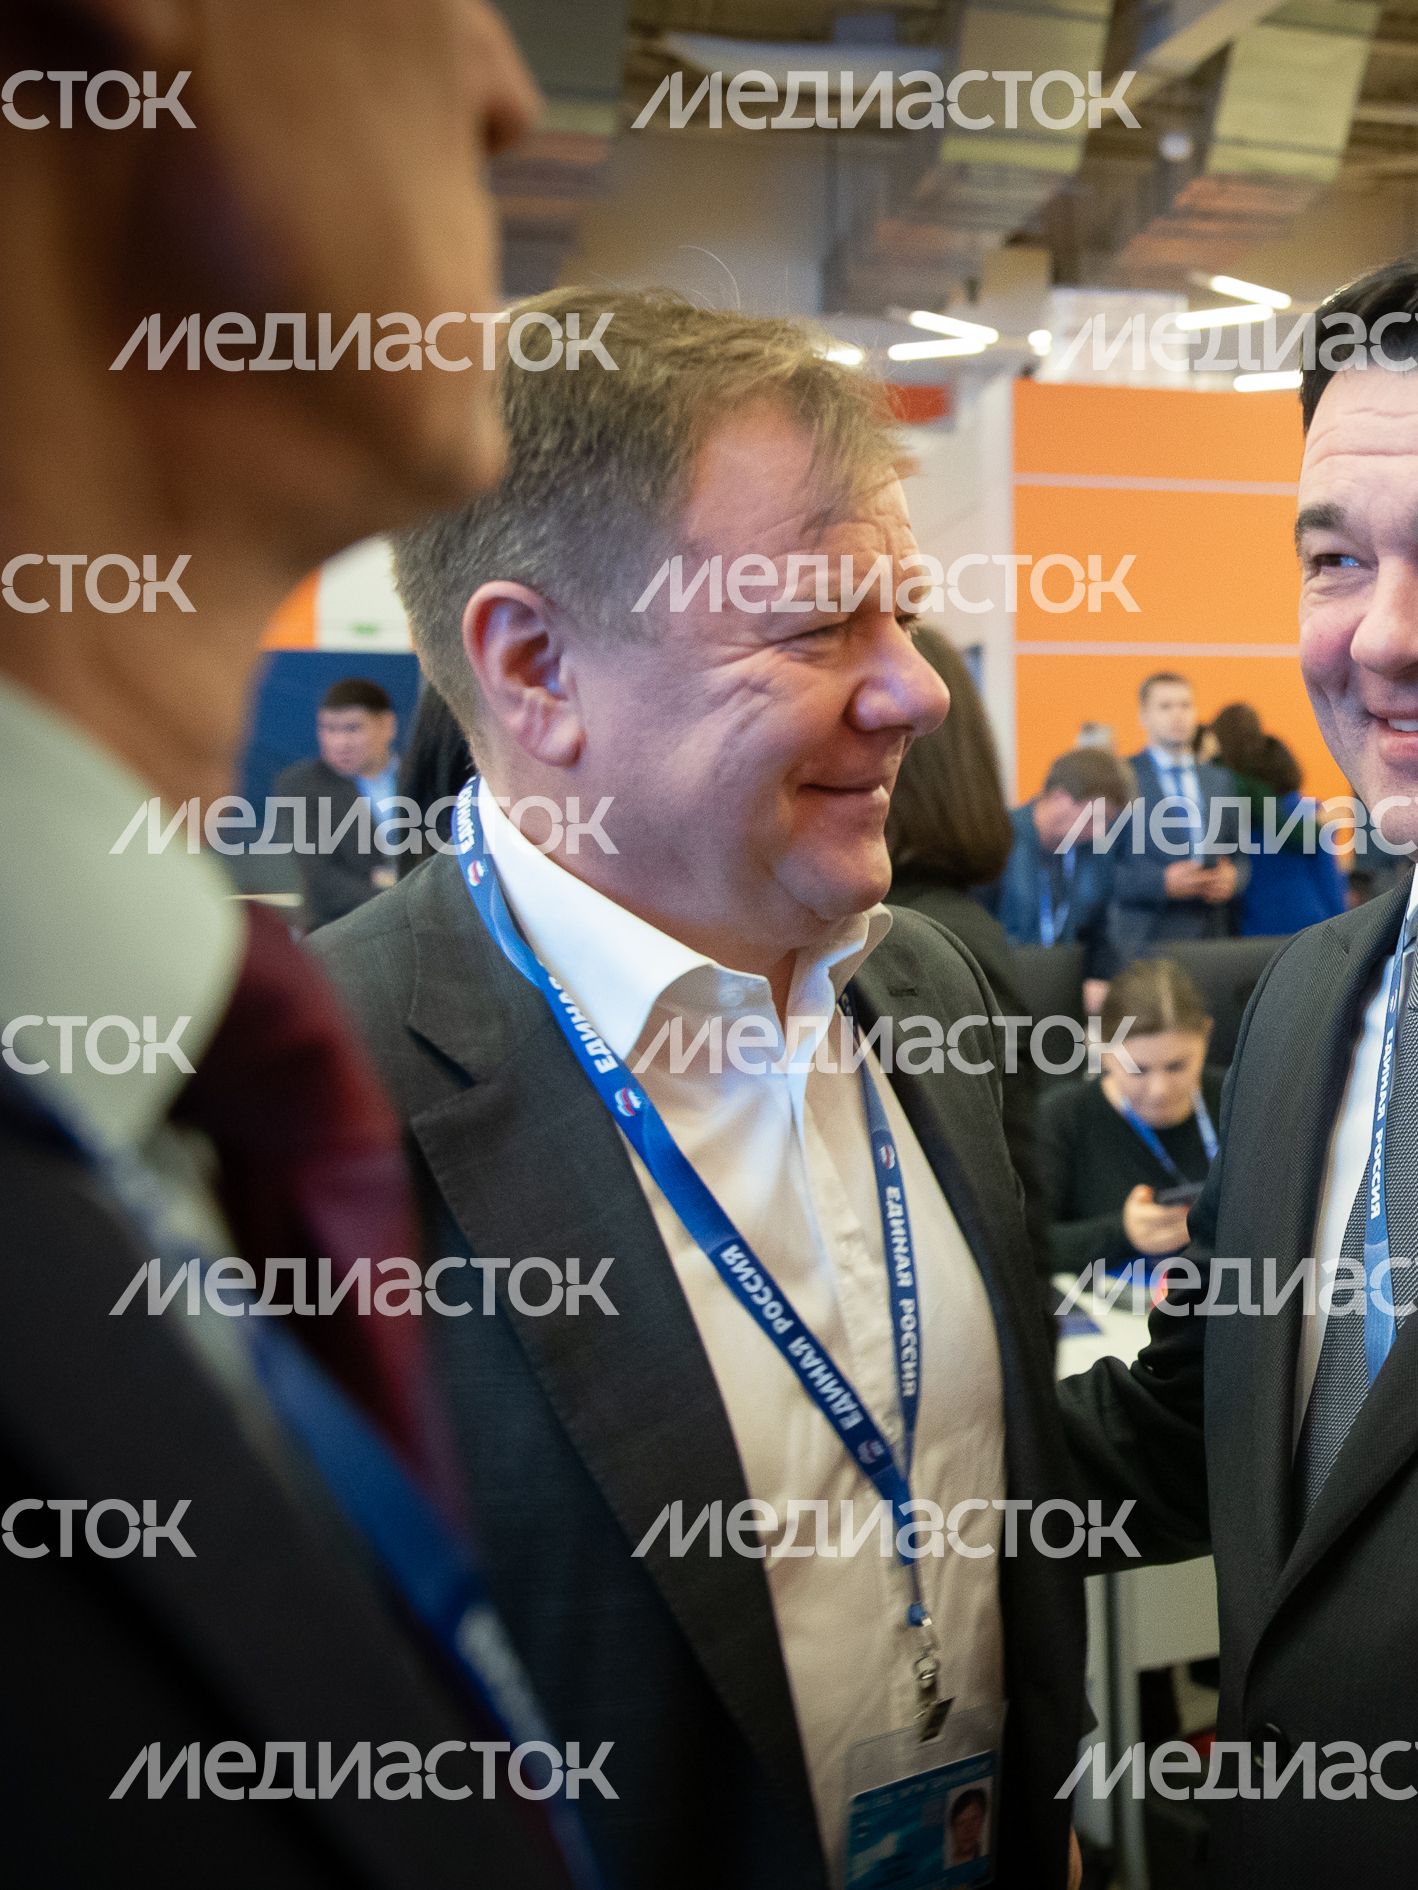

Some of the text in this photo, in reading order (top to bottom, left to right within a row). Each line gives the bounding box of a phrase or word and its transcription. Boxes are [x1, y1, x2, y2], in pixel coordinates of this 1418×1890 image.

[1371, 1127, 1384, 1219] РОССИЯ
[720, 1244, 864, 1430] ЕДИНАЯ РОССИЯ
[886, 1186, 917, 1397] ЕДИНАЯ РОССИЯ
